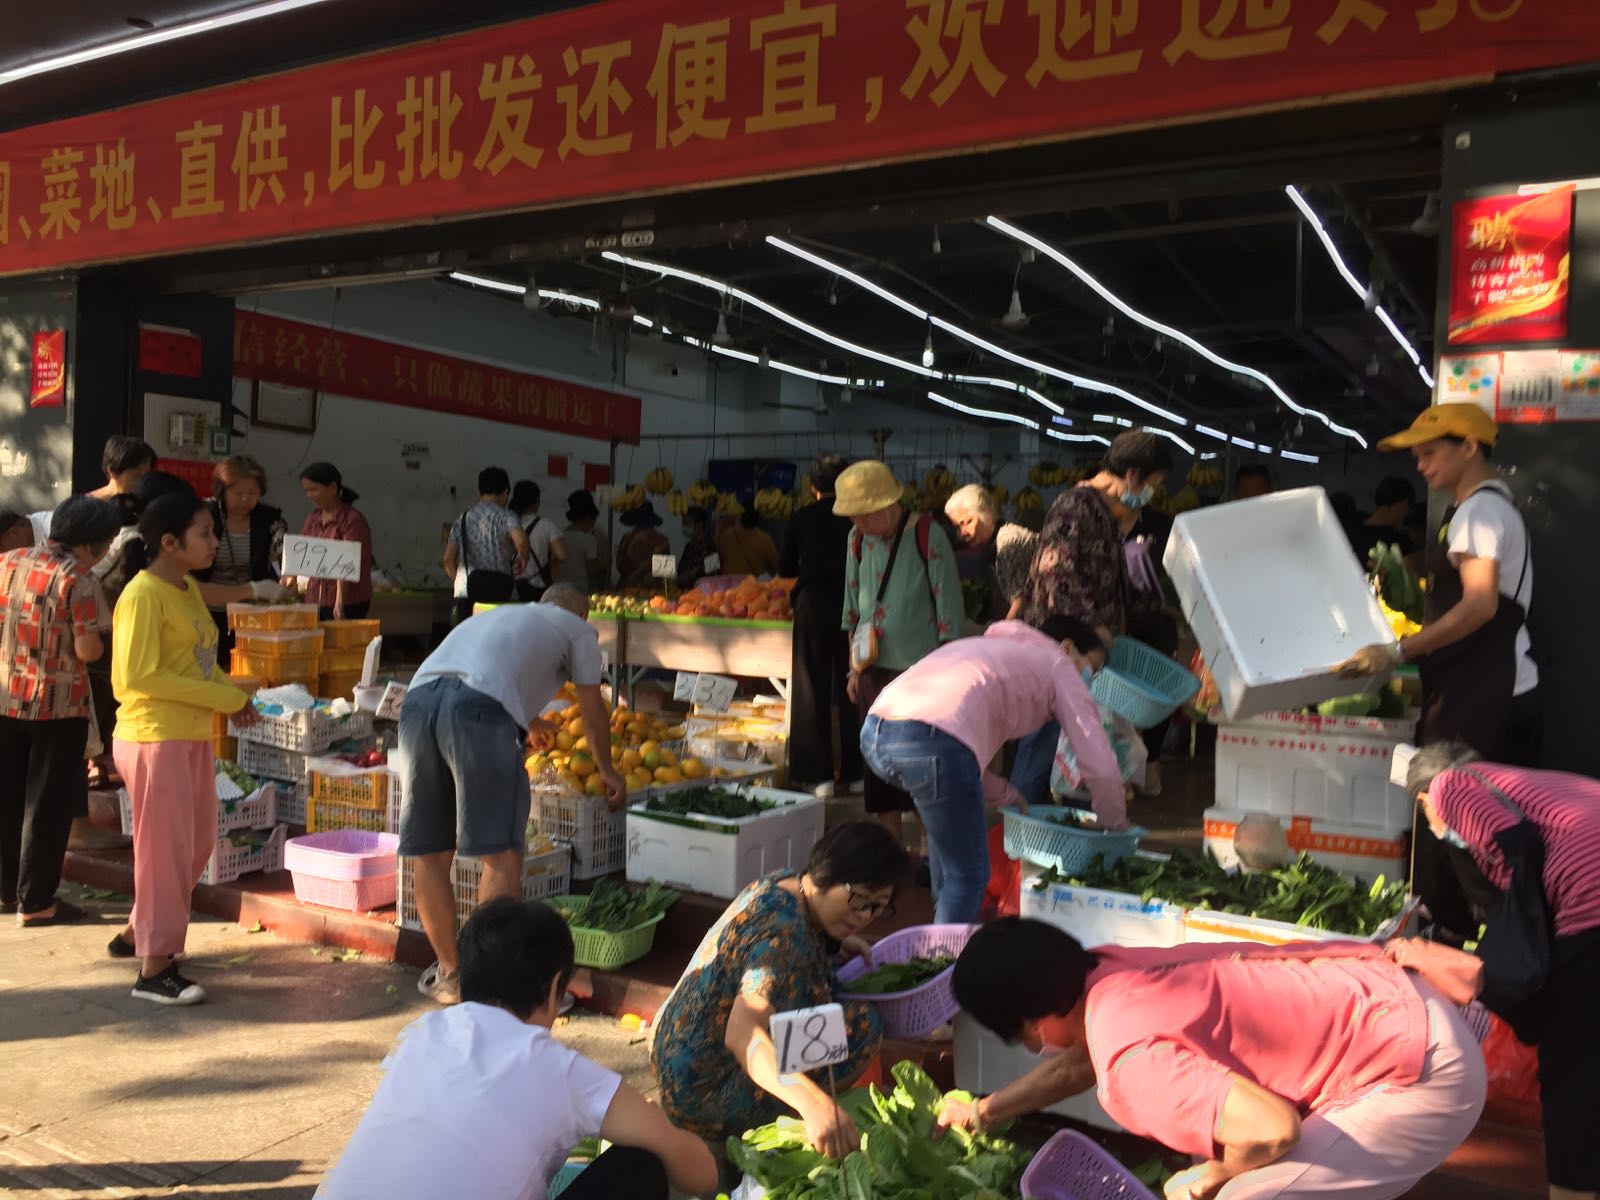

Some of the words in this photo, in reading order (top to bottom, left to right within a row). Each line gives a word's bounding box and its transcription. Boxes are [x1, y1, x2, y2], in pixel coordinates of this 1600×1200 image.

[0, 0, 1522, 244] 、菜地、直供,比批发还便宜,欢迎
